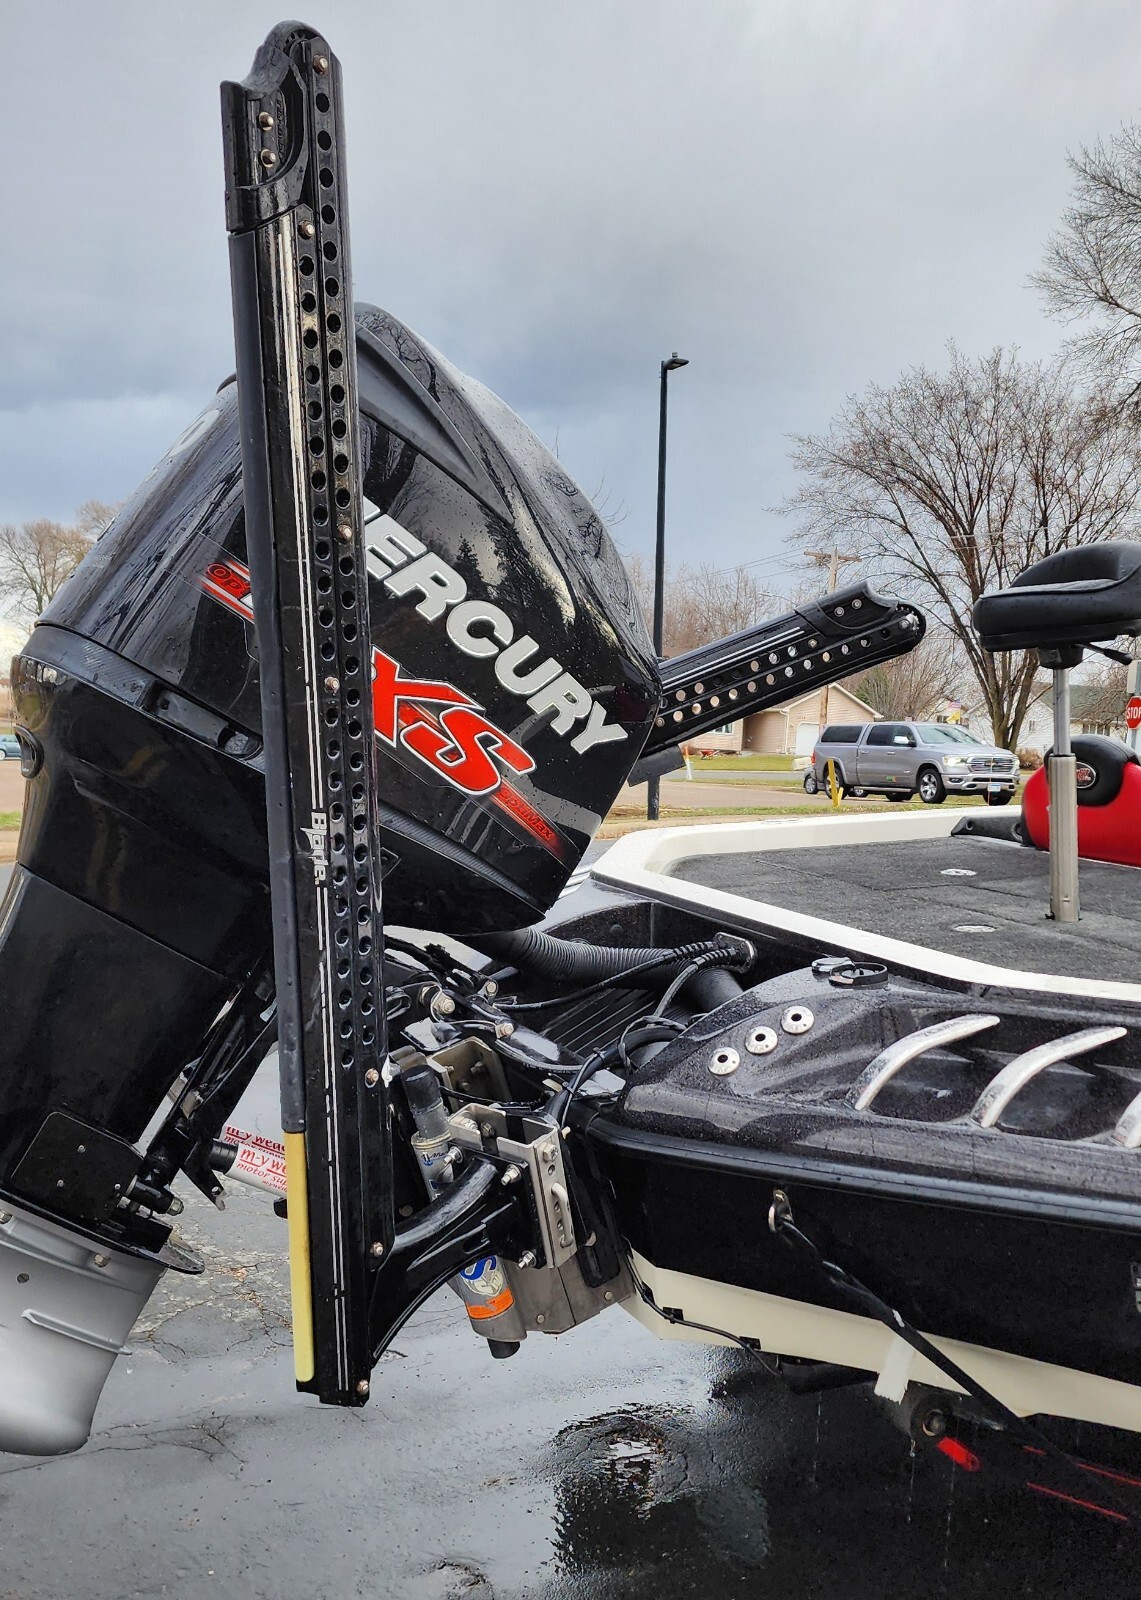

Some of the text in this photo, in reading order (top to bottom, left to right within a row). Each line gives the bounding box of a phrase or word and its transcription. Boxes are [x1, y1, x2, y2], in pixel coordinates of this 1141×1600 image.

[364, 496, 629, 754] ERCURY
[300, 811, 329, 886] Blade
[236, 1163, 271, 1178] motor
